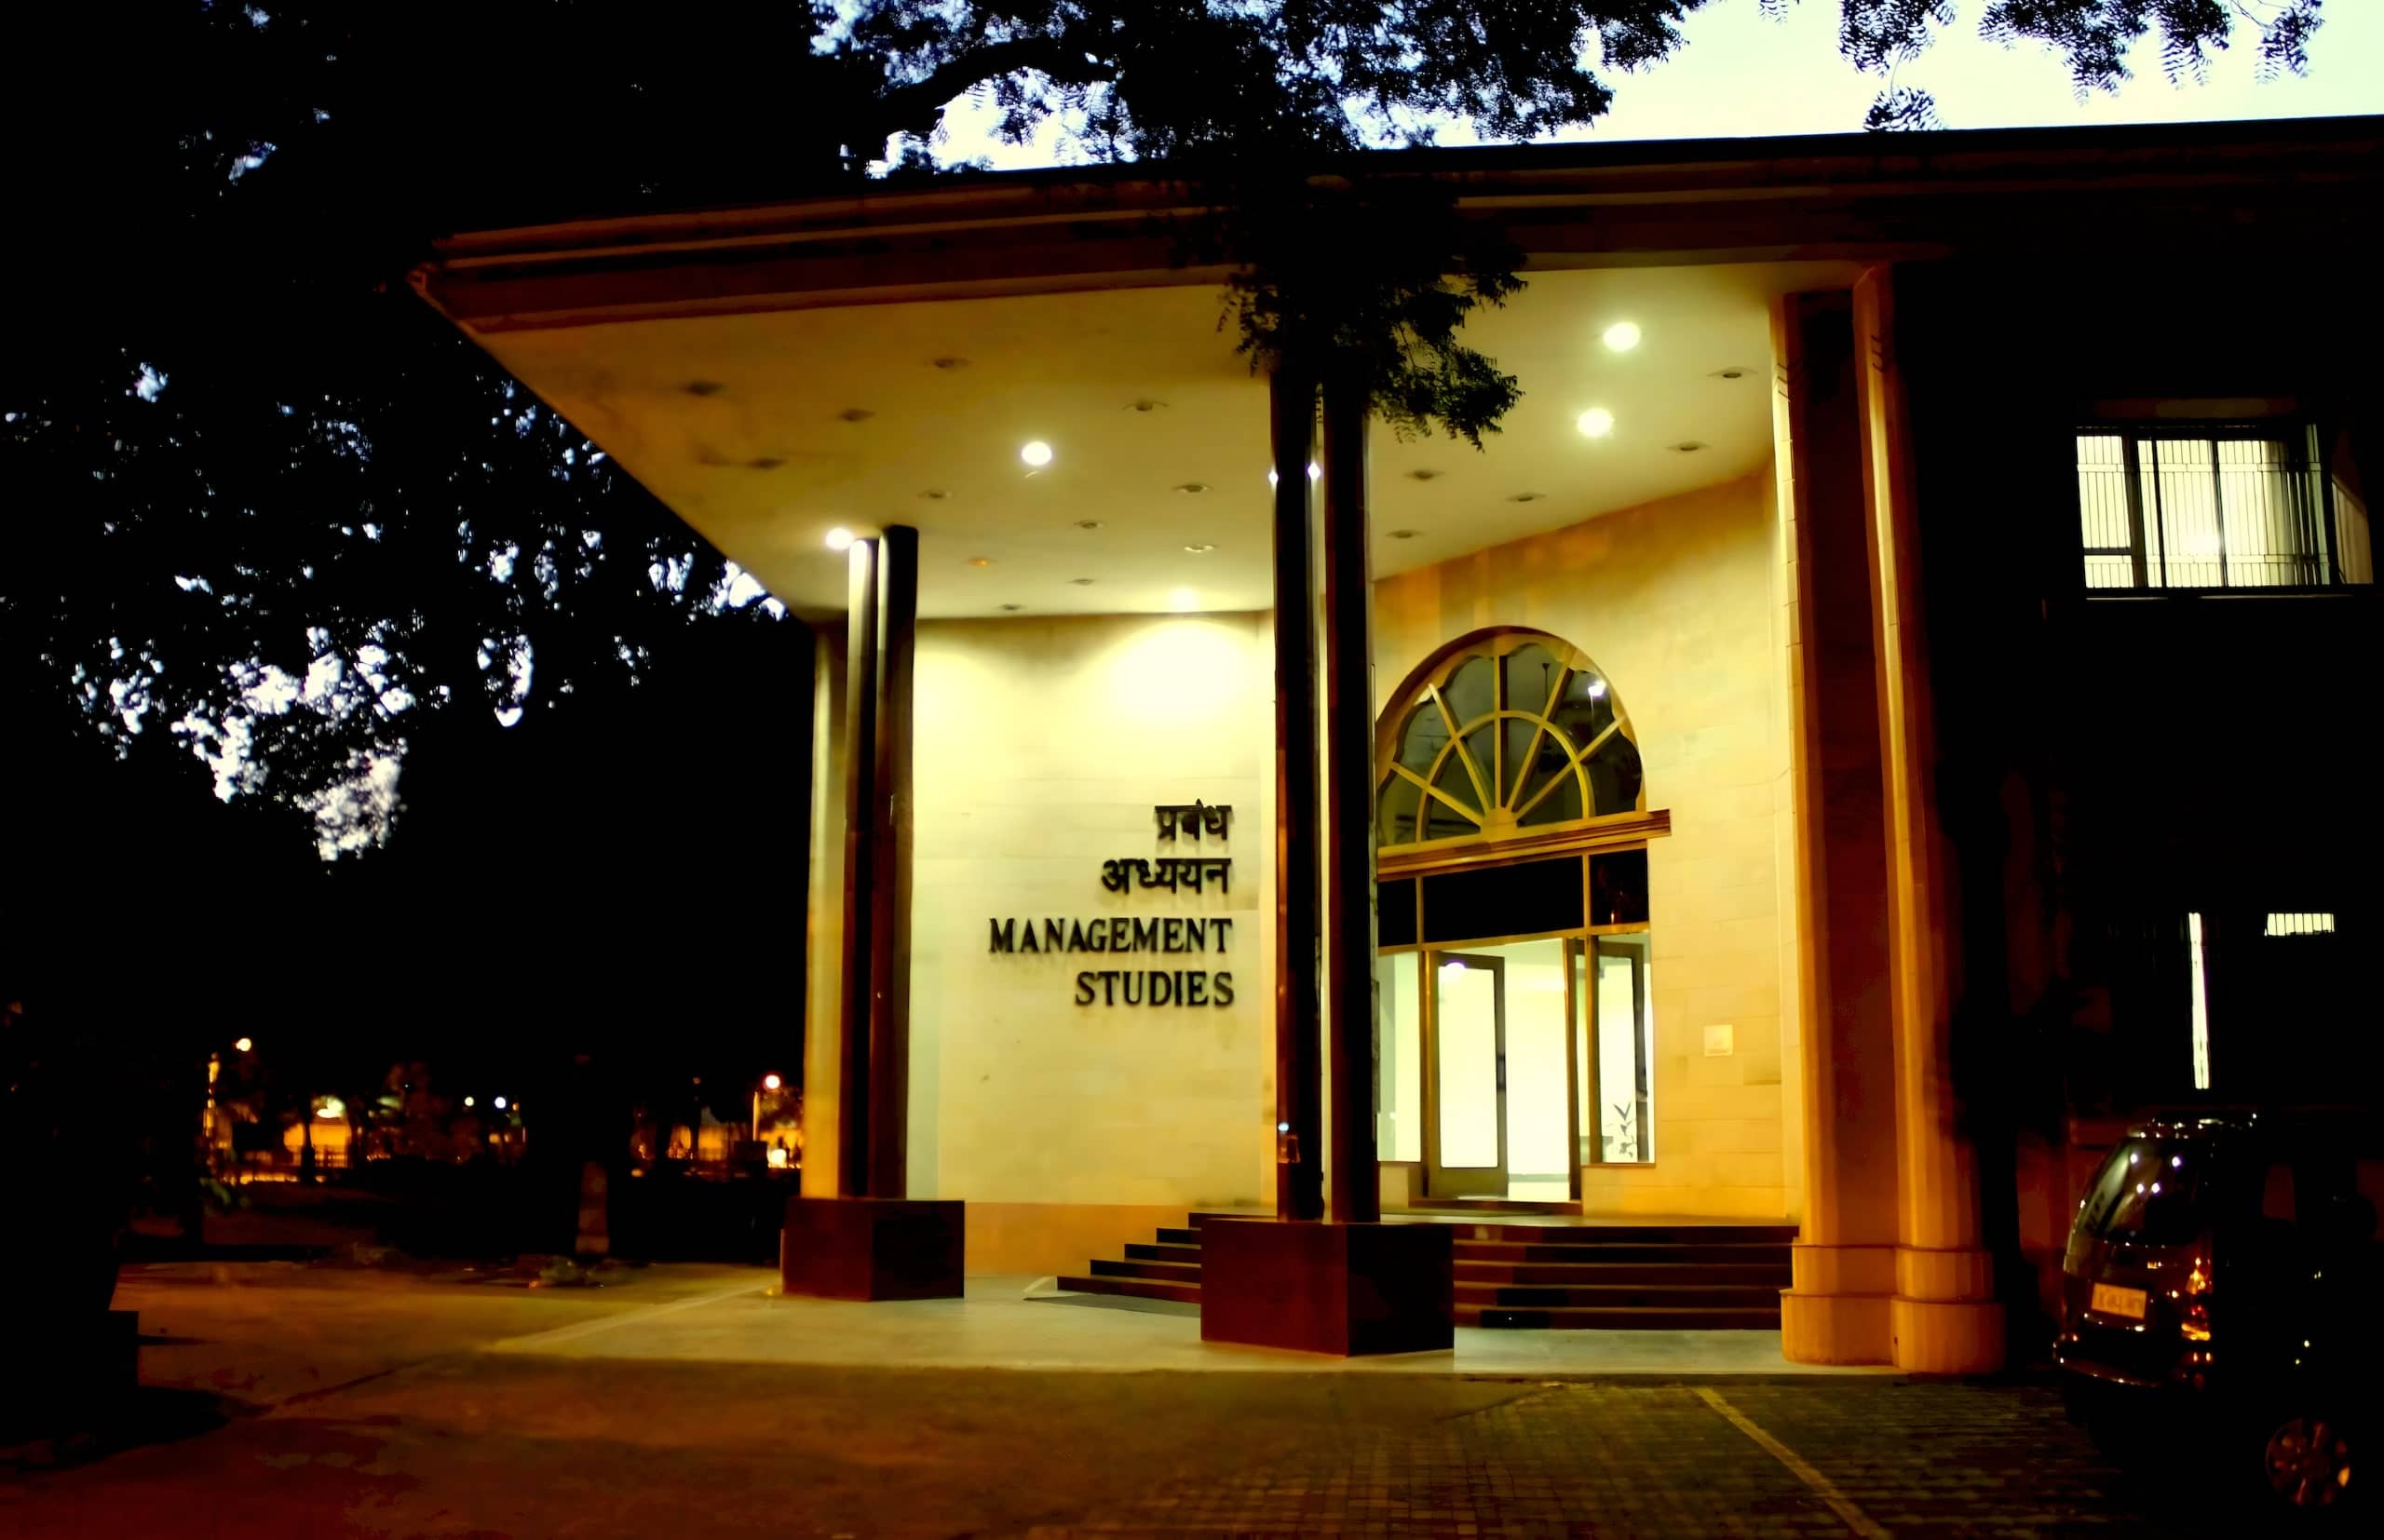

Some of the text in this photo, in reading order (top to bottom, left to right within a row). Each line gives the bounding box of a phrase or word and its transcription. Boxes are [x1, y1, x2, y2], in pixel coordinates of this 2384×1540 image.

[1155, 798, 1232, 841] प्रबंध
[1102, 858, 1232, 894] अध्ययन
[989, 917, 1232, 953] MANAGEMENT
[1075, 971, 1234, 1006] STUDIES
